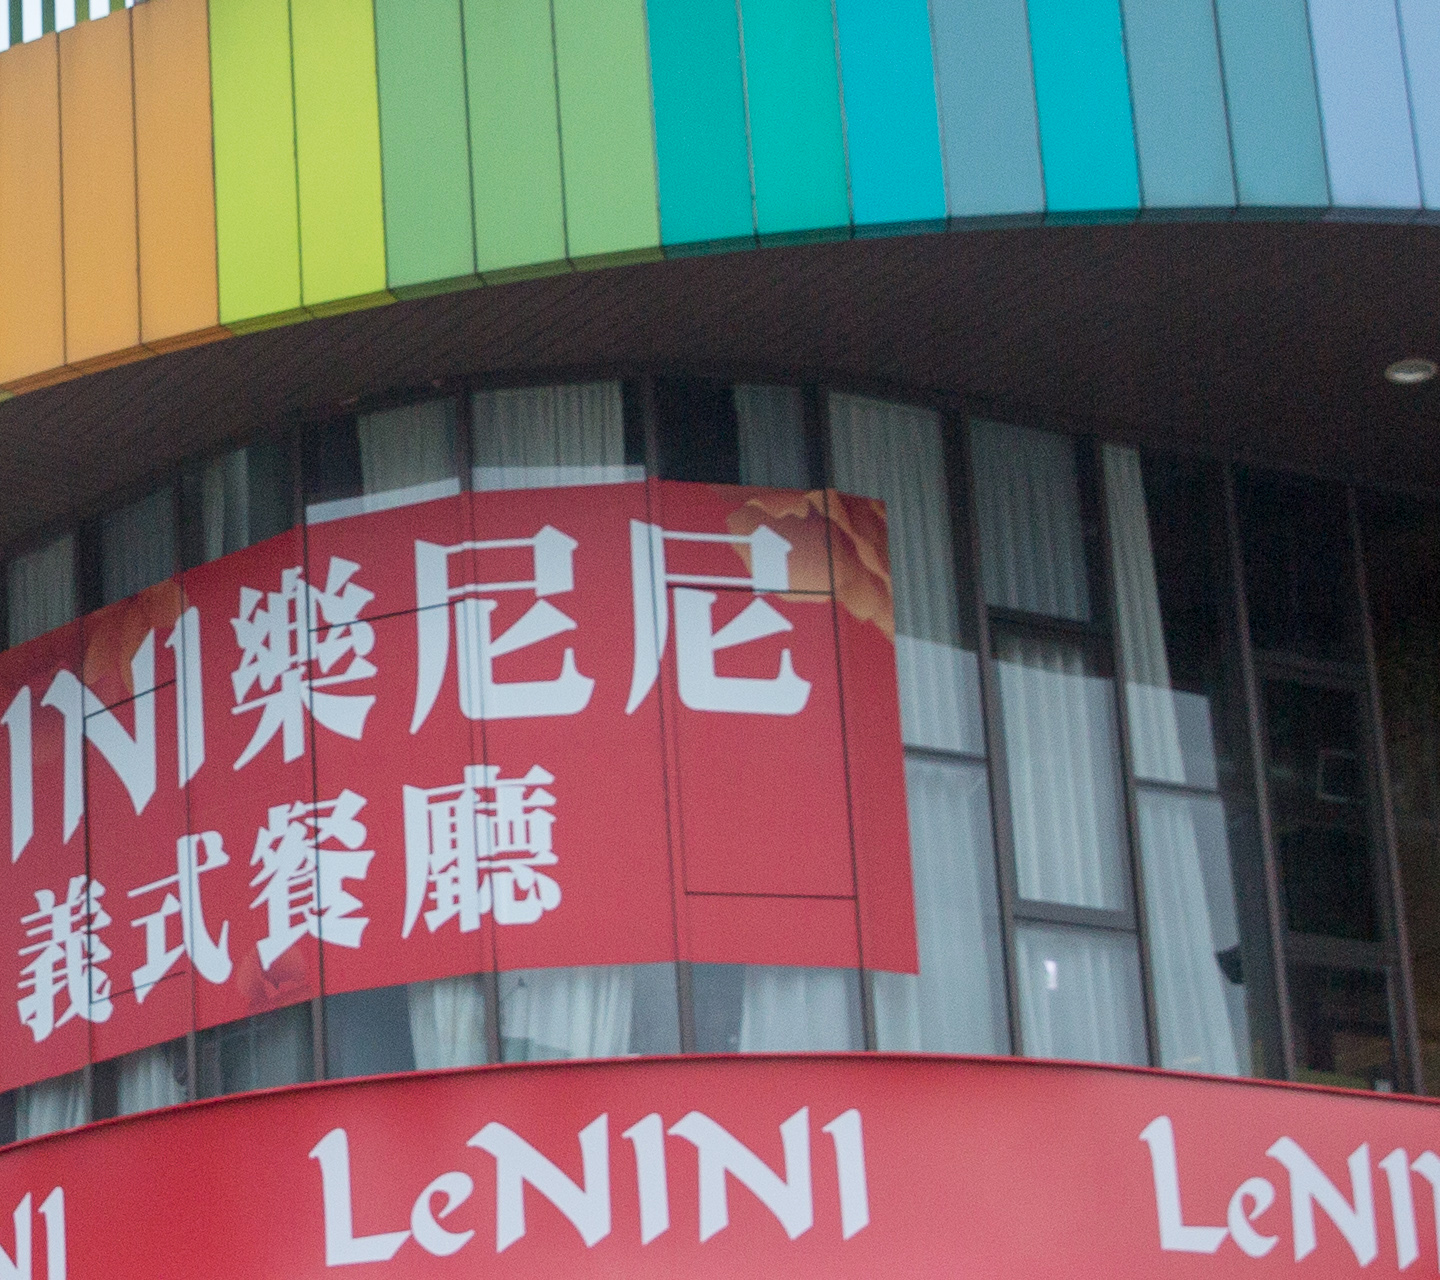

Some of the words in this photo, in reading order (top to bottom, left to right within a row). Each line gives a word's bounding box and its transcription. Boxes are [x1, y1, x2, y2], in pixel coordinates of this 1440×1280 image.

[228, 518, 814, 772] 樂尼尼
[17, 763, 562, 1043] 義式餐廳
[309, 1106, 870, 1267] LeNINI
